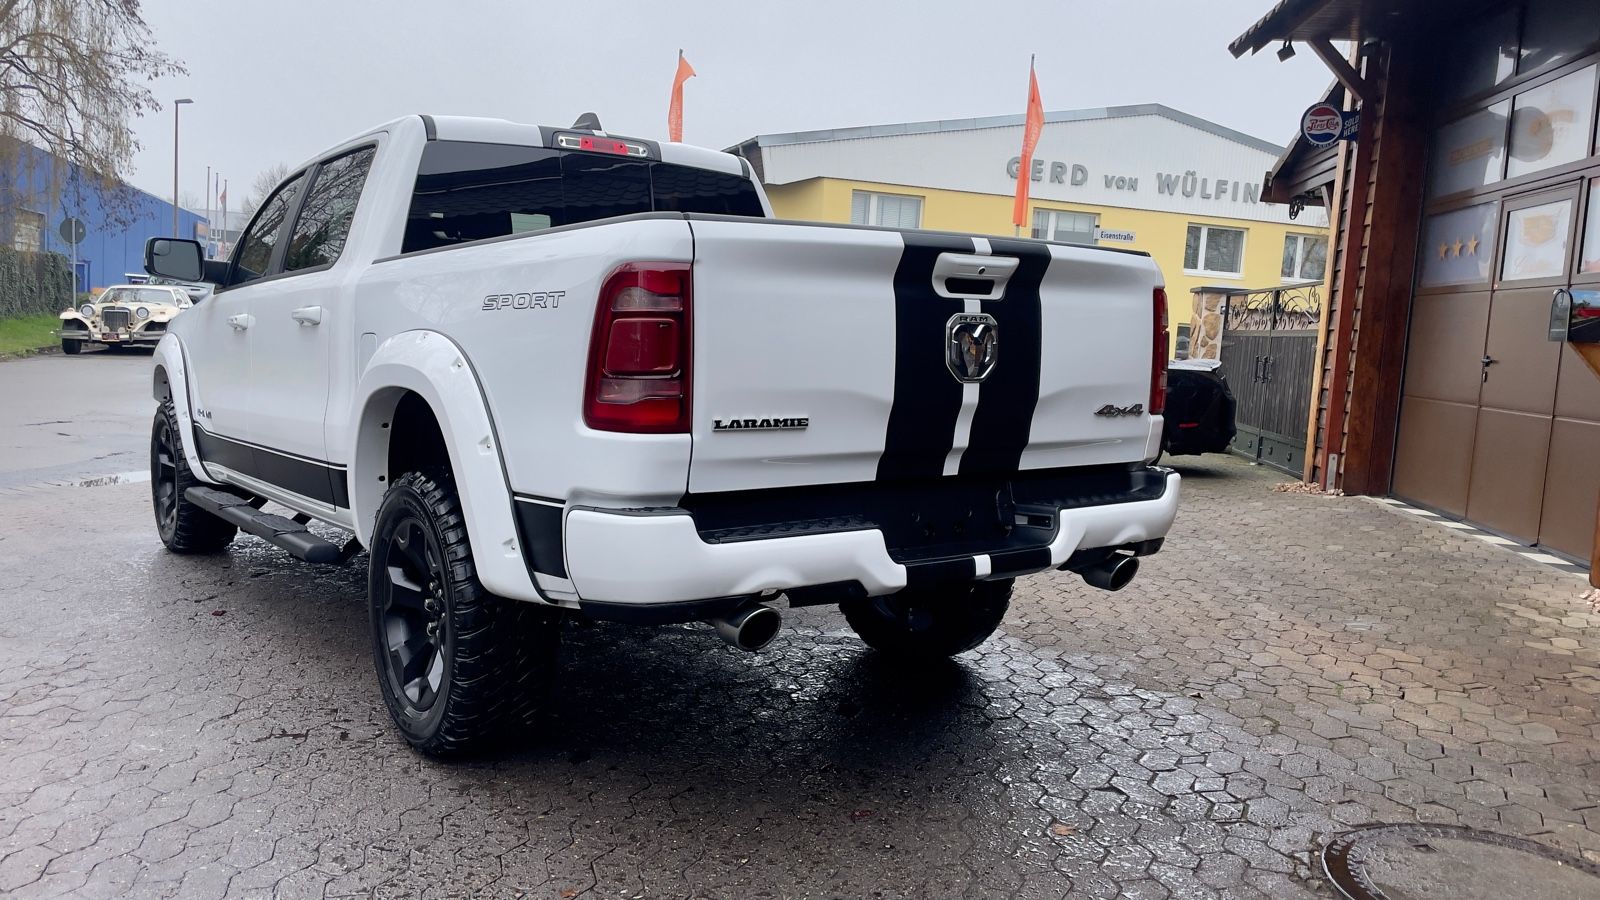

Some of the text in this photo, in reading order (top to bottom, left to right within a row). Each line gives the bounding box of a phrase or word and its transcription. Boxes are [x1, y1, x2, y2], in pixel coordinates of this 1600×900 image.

[1344, 115, 1360, 129] SOLD
[1343, 123, 1360, 137] HERE
[1007, 156, 1260, 204] GERD VON WÜLFIN
[1100, 231, 1134, 240] Eisenstraße
[482, 291, 566, 310] SPORT
[959, 315, 989, 323] RAM
[712, 417, 809, 432] LARAMIE
